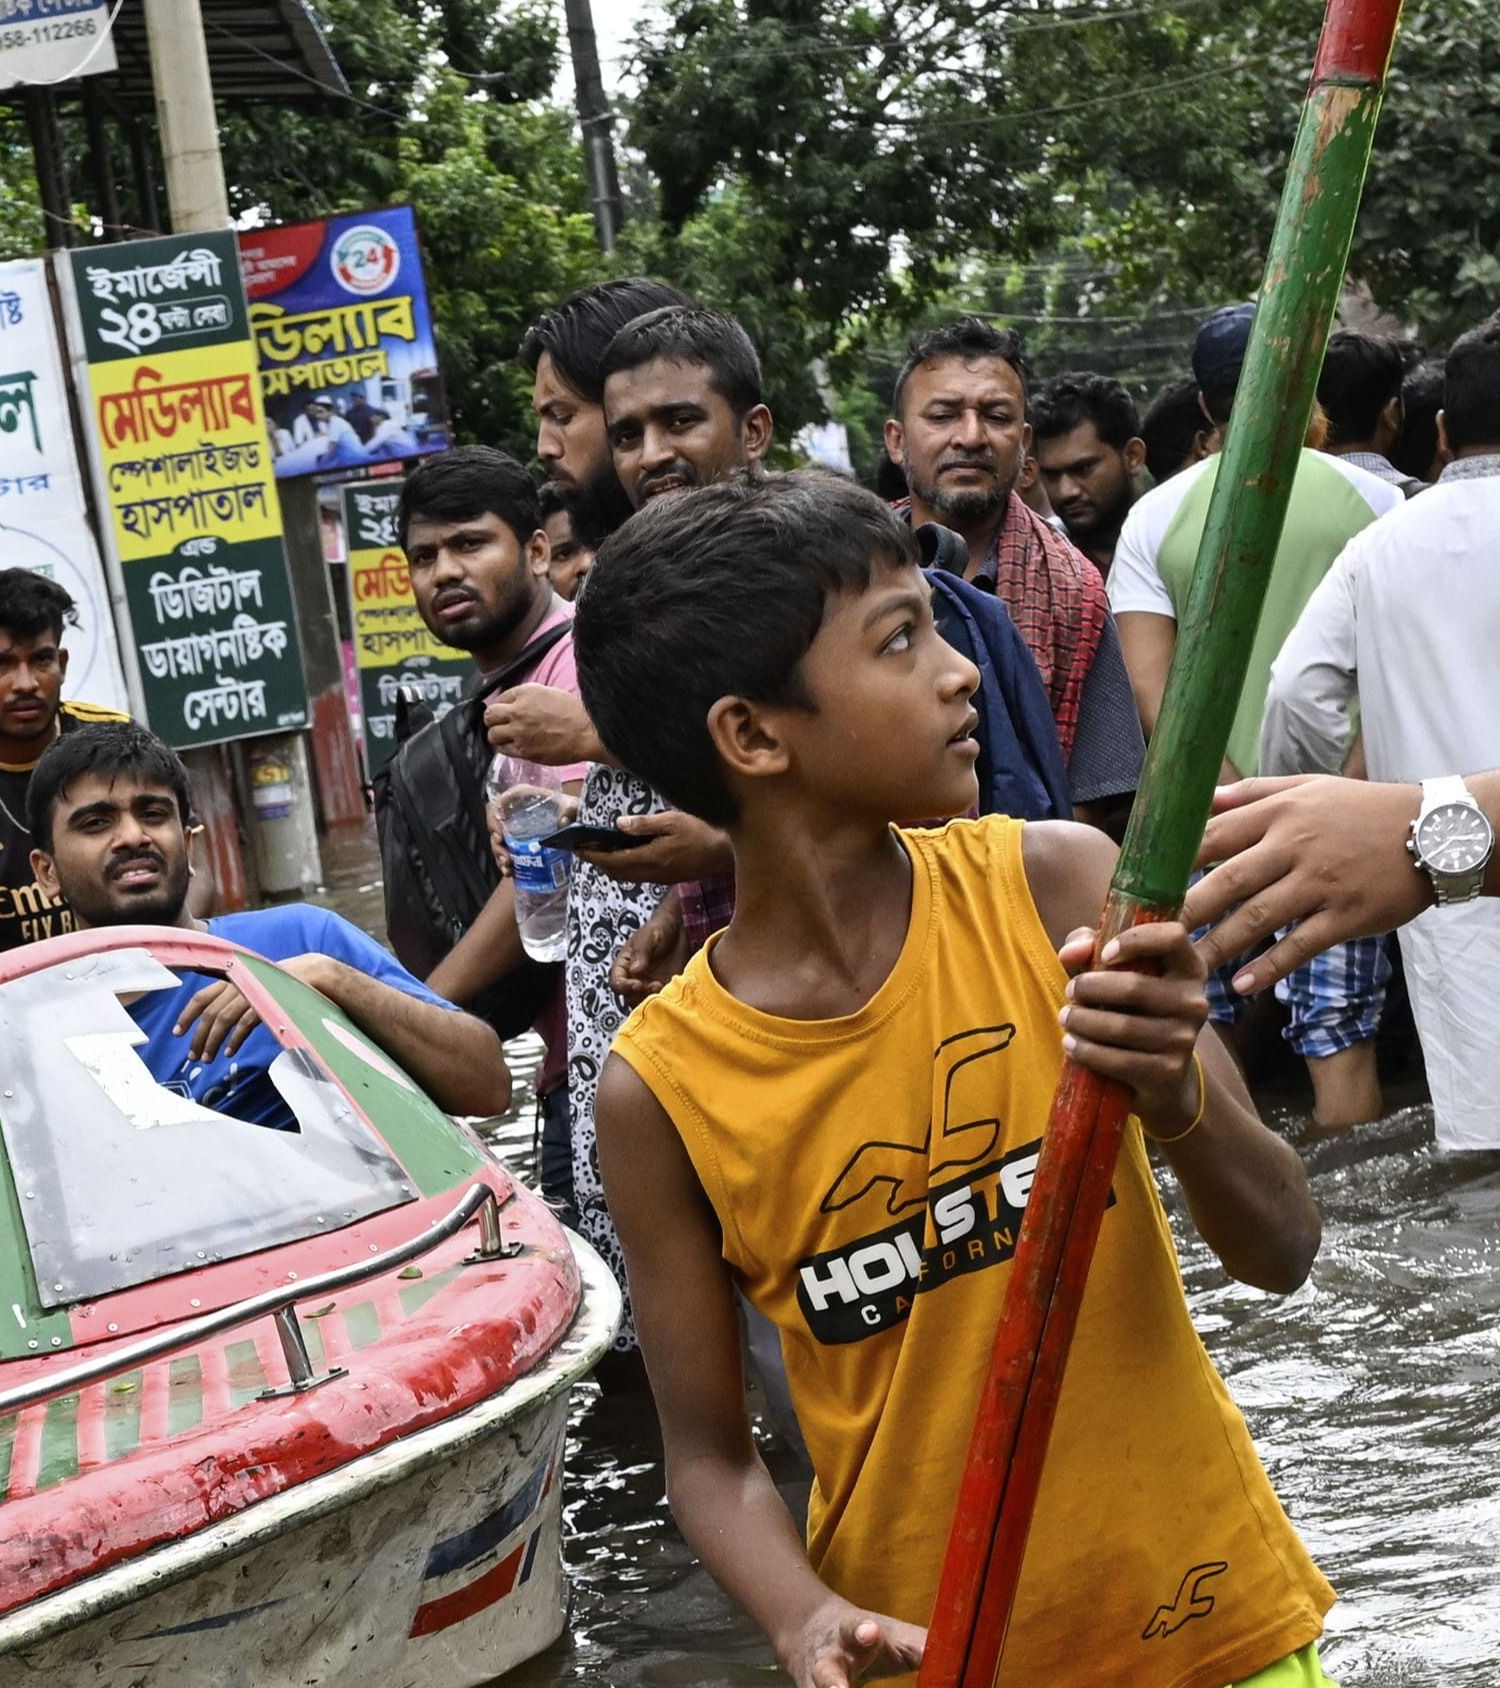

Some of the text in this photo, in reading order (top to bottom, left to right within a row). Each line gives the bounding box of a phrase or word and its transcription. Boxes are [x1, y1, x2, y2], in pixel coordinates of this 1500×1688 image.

[98, 302, 162, 354] ২৪
[249, 295, 416, 364] ডিল্যাব
[261, 350, 389, 397] সপাতাল
[99, 366, 255, 449] মেডিল্যাব
[115, 481, 268, 538] হাসপাতাল
[148, 563, 263, 624] ডিজিটাল
[184, 673, 267, 731] সেন্টার
